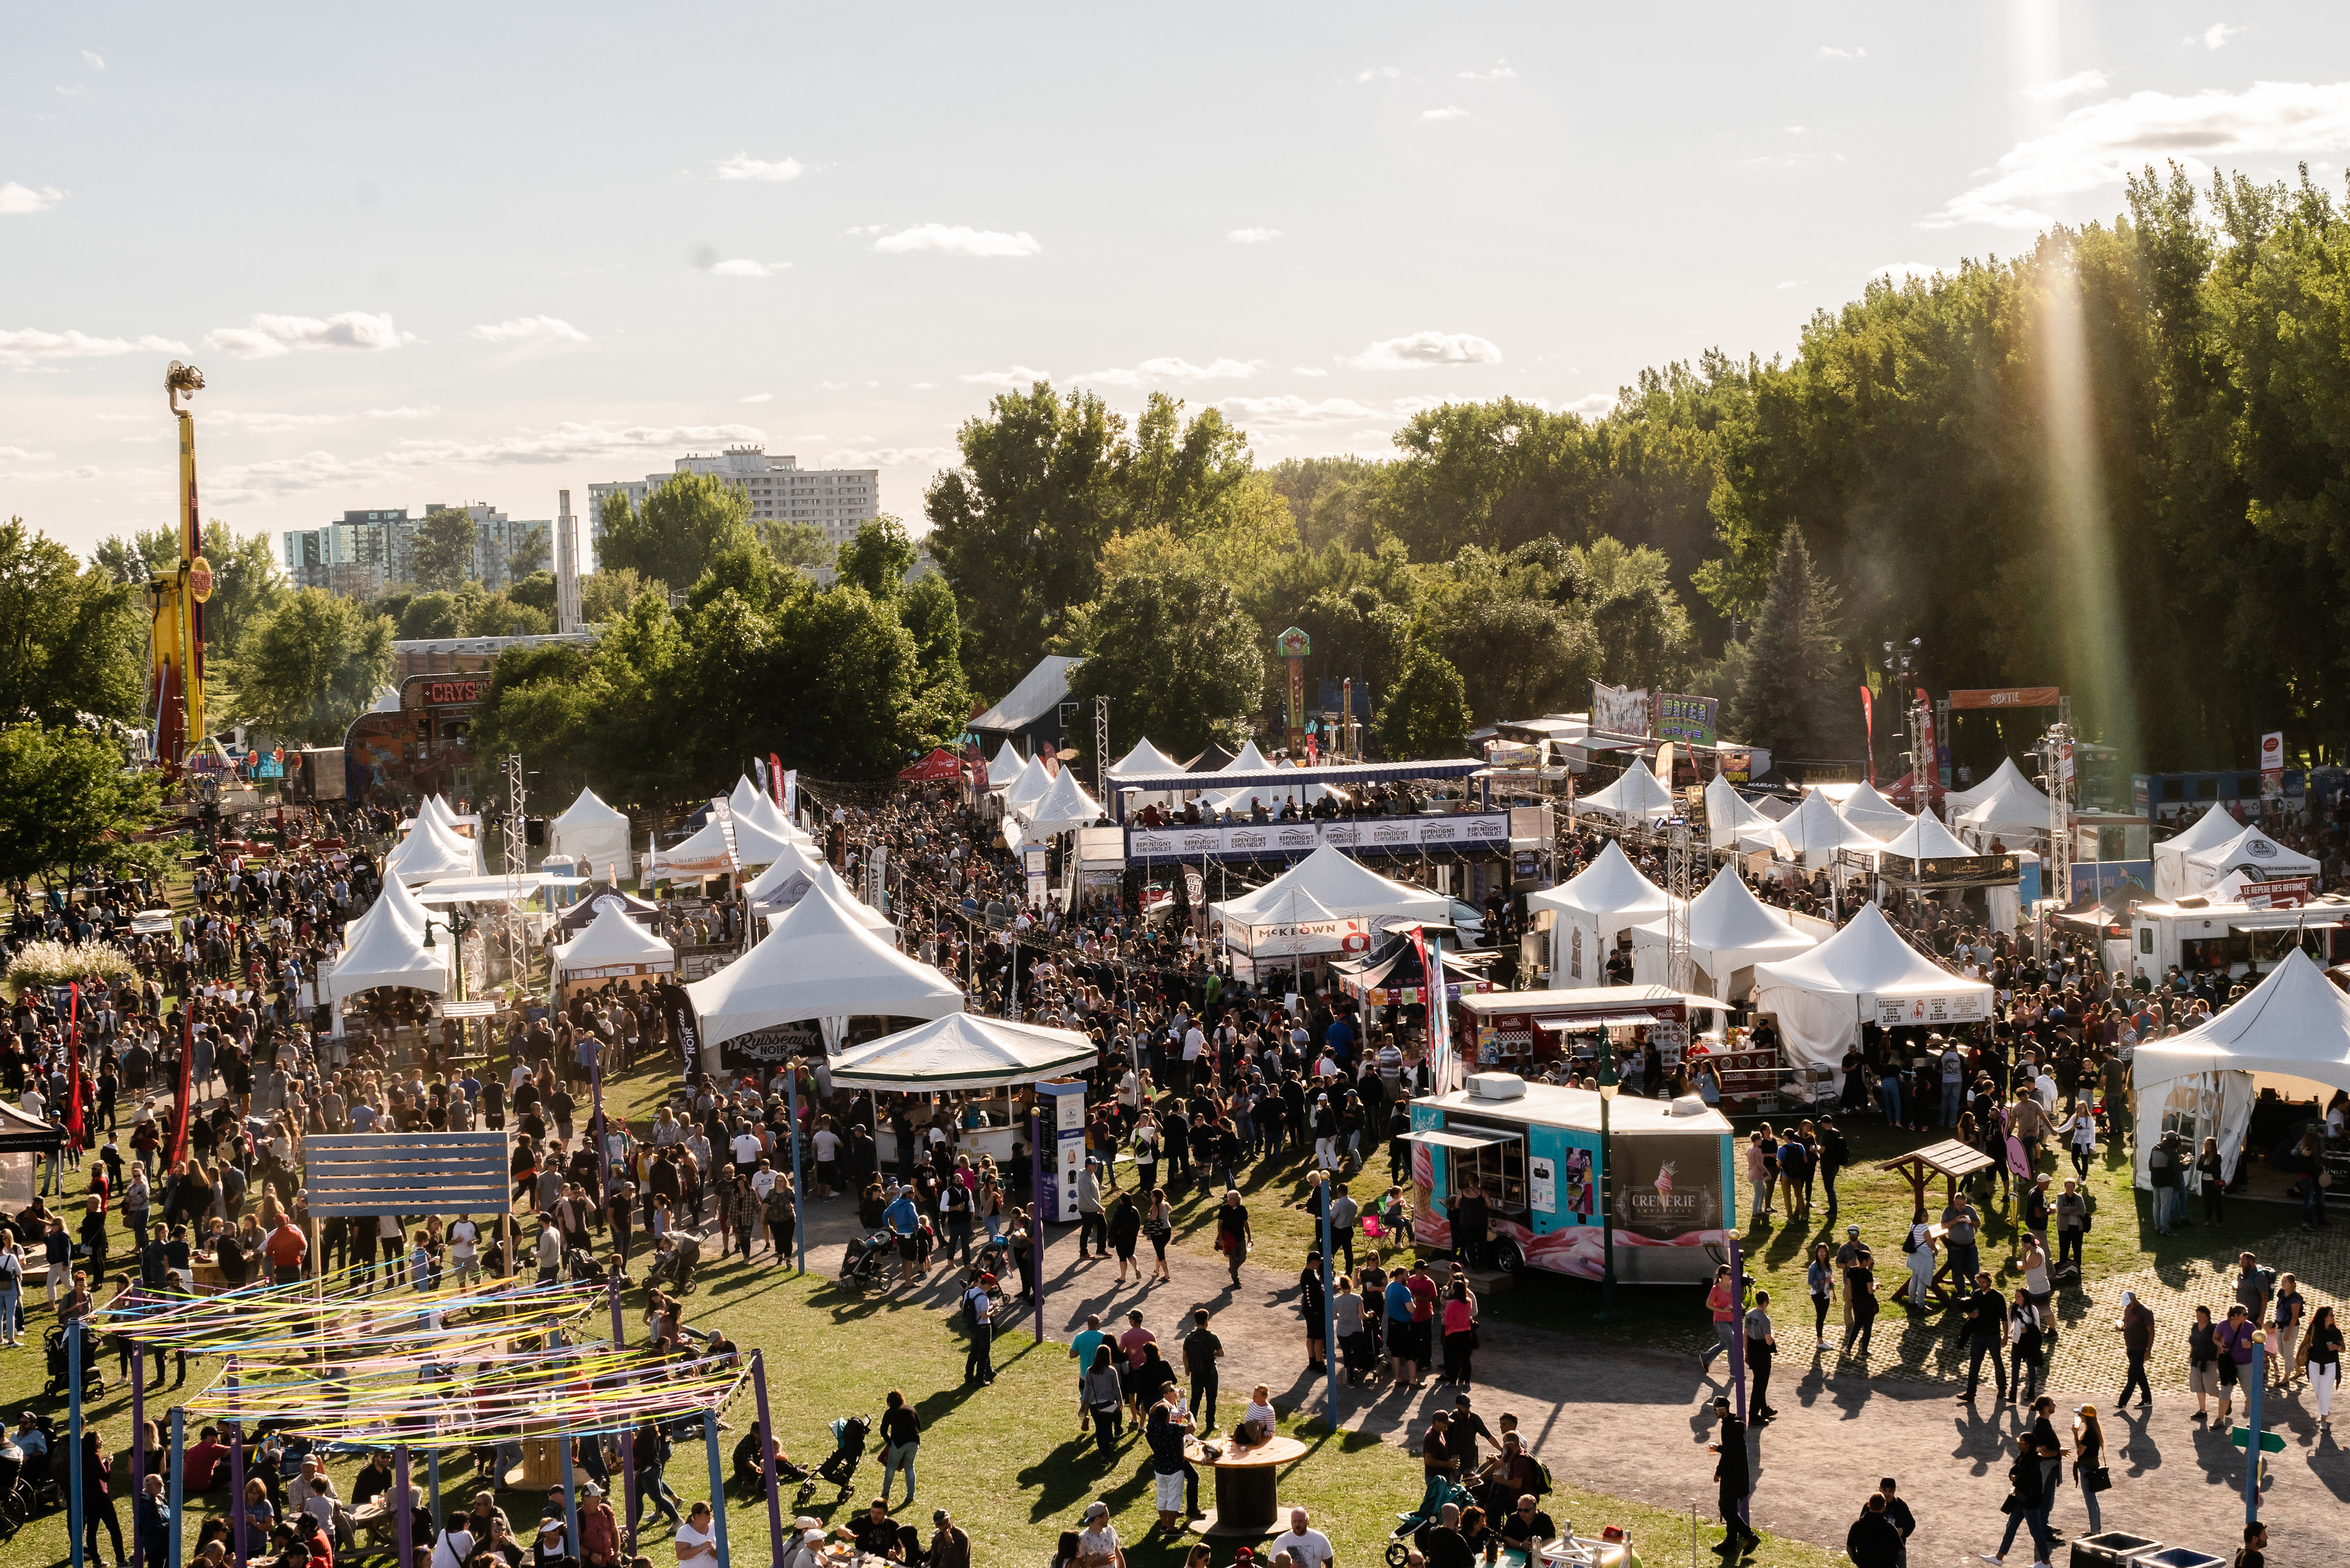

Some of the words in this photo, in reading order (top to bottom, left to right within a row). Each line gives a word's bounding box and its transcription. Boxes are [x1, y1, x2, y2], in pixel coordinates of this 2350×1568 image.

[1991, 692, 2020, 704] SORTIE
[1724, 771, 1748, 782] COUPONS
[675, 855, 716, 864] CHARCUTERIE
[2251, 885, 2271, 894] REPERE
[2272, 884, 2282, 892] DES
[2283, 881, 2307, 892] AFFAMÉS
[1259, 924, 1336, 938] McKEOWN
[685, 1027, 696, 1054] NOIR
[738, 1033, 808, 1050] Ruisseau
[760, 1045, 788, 1055] NOIR
[1632, 1195, 1696, 1207] CREMERIE
